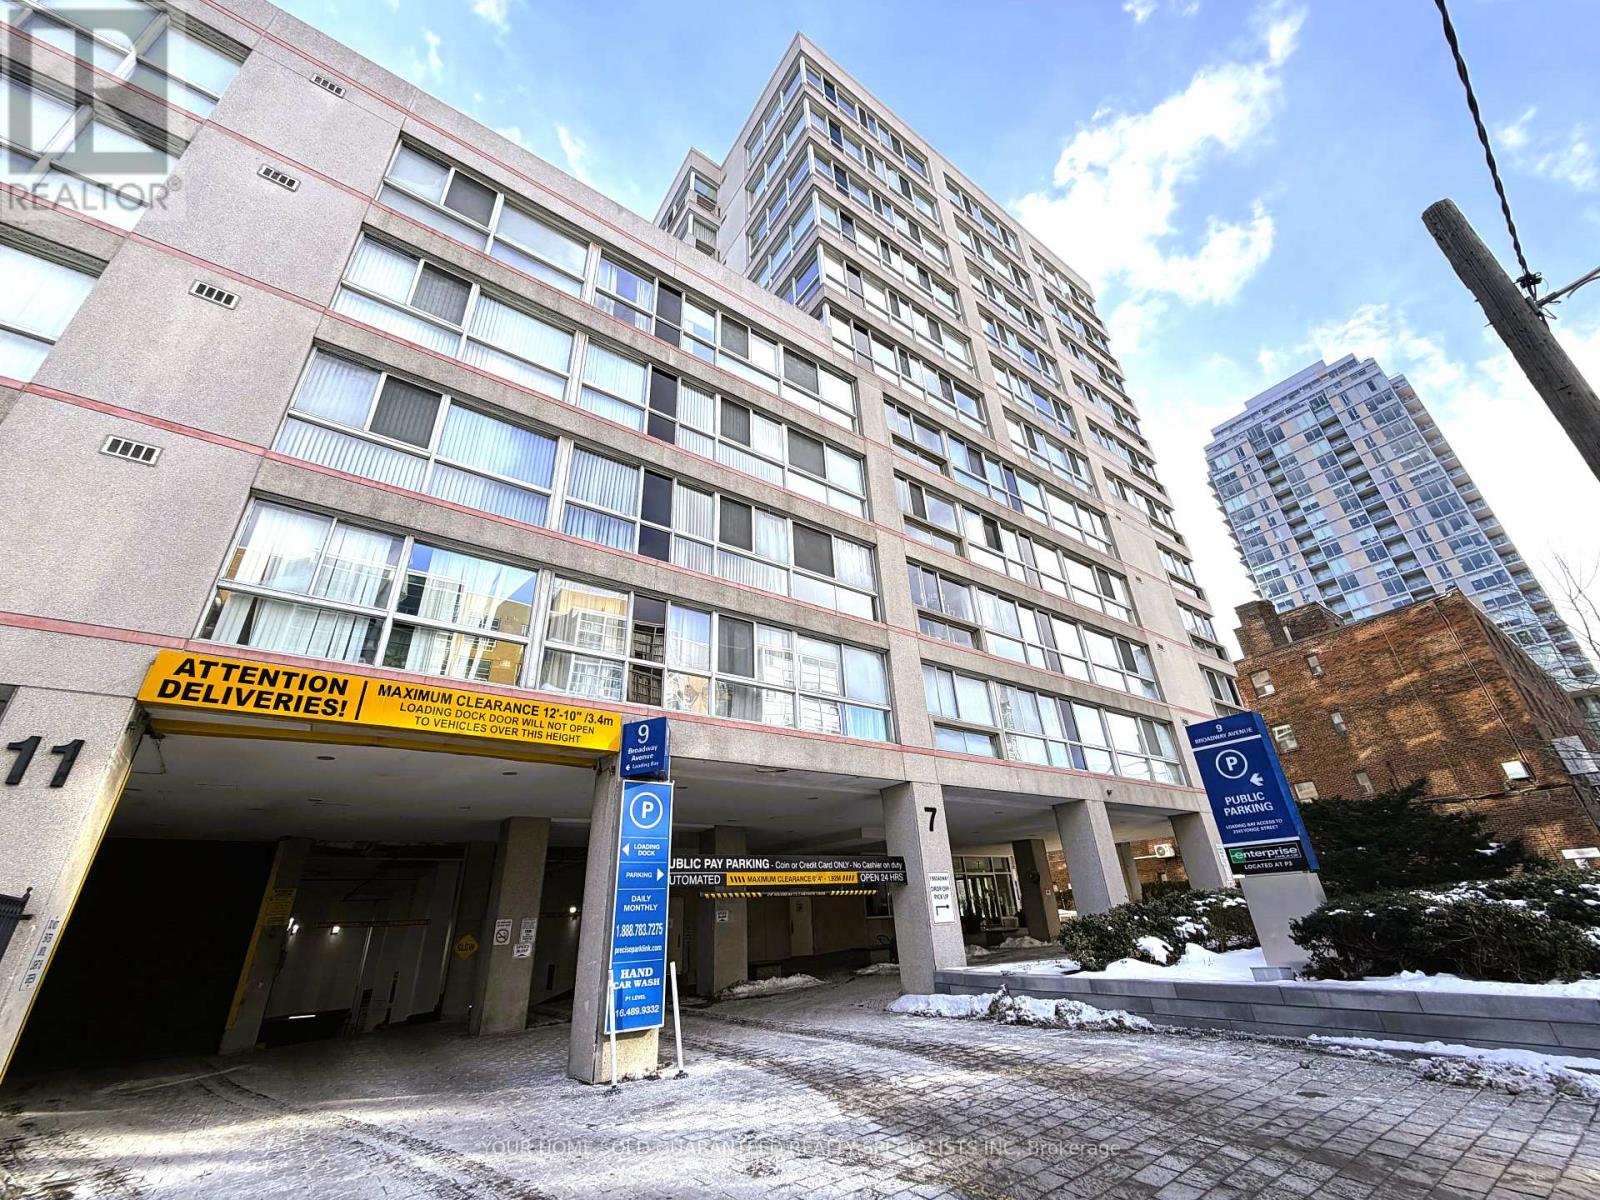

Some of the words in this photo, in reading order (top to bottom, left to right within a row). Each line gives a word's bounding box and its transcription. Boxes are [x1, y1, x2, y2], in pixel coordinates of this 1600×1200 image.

[173, 658, 348, 695] ATTENTION
[157, 679, 348, 717] DELIVERIES!
[377, 684, 453, 705] MAXIMUM
[456, 695, 539, 717] CLEARANCE
[584, 712, 613, 726] /3.4m
[400, 702, 452, 718] LOADING
[455, 709, 485, 721] DOCK
[488, 714, 519, 726] DOOR
[521, 718, 545, 729] WILL
[547, 721, 567, 732] NOT
[569, 724, 595, 735] OPEN
[414, 716, 430, 726] TO
[433, 718, 487, 734] VEHICLES
[489, 725, 518, 738] OVER
[521, 728, 543, 739] THIS
[545, 731, 581, 744] HEIGHT
[637, 724, 649, 744] 9
[1215, 724, 1223, 732] 9
[1194, 733, 1227, 744] BROADWAY
[1228, 726, 1253, 737] AVENUE
[627, 745, 659, 755] Broadway
[5, 736, 85, 787] 11
[631, 753, 654, 761] Avenue
[1225, 756, 1238, 771] P
[1224, 791, 1265, 805] PUBLIC
[641, 801, 654, 819] P
[1223, 801, 1274, 816] PARKING
[924, 807, 937, 832] 7
[1234, 846, 1298, 859] enterprise
[669, 858, 701, 869] UBLIC
[704, 858, 724, 869] PAY
[726, 858, 770, 869] PARKING
[775, 860, 790, 869] Coin
[798, 860, 816, 869] Credit
[818, 860, 833, 869] Card
[833, 861, 849, 869] ONLY
[861, 861, 882, 869] Cashier
[1244, 861, 1273, 870] LOCATED
[625, 871, 653, 879] PARKING
[669, 874, 721, 885] UTOMATED
[779, 875, 811, 883] CLEARANCE
[860, 874, 880, 882] OPEN
[880, 874, 889, 882] 24
[889, 873, 904, 881] HRS
[623, 904, 658, 912] MONTHLY
[614, 944, 662, 955] preciseparklink.com
[620, 967, 653, 979] HAND
[613, 980, 631, 990] CAR
[634, 978, 660, 988] WASH
[614, 1004, 660, 1017] 16.489.9332
